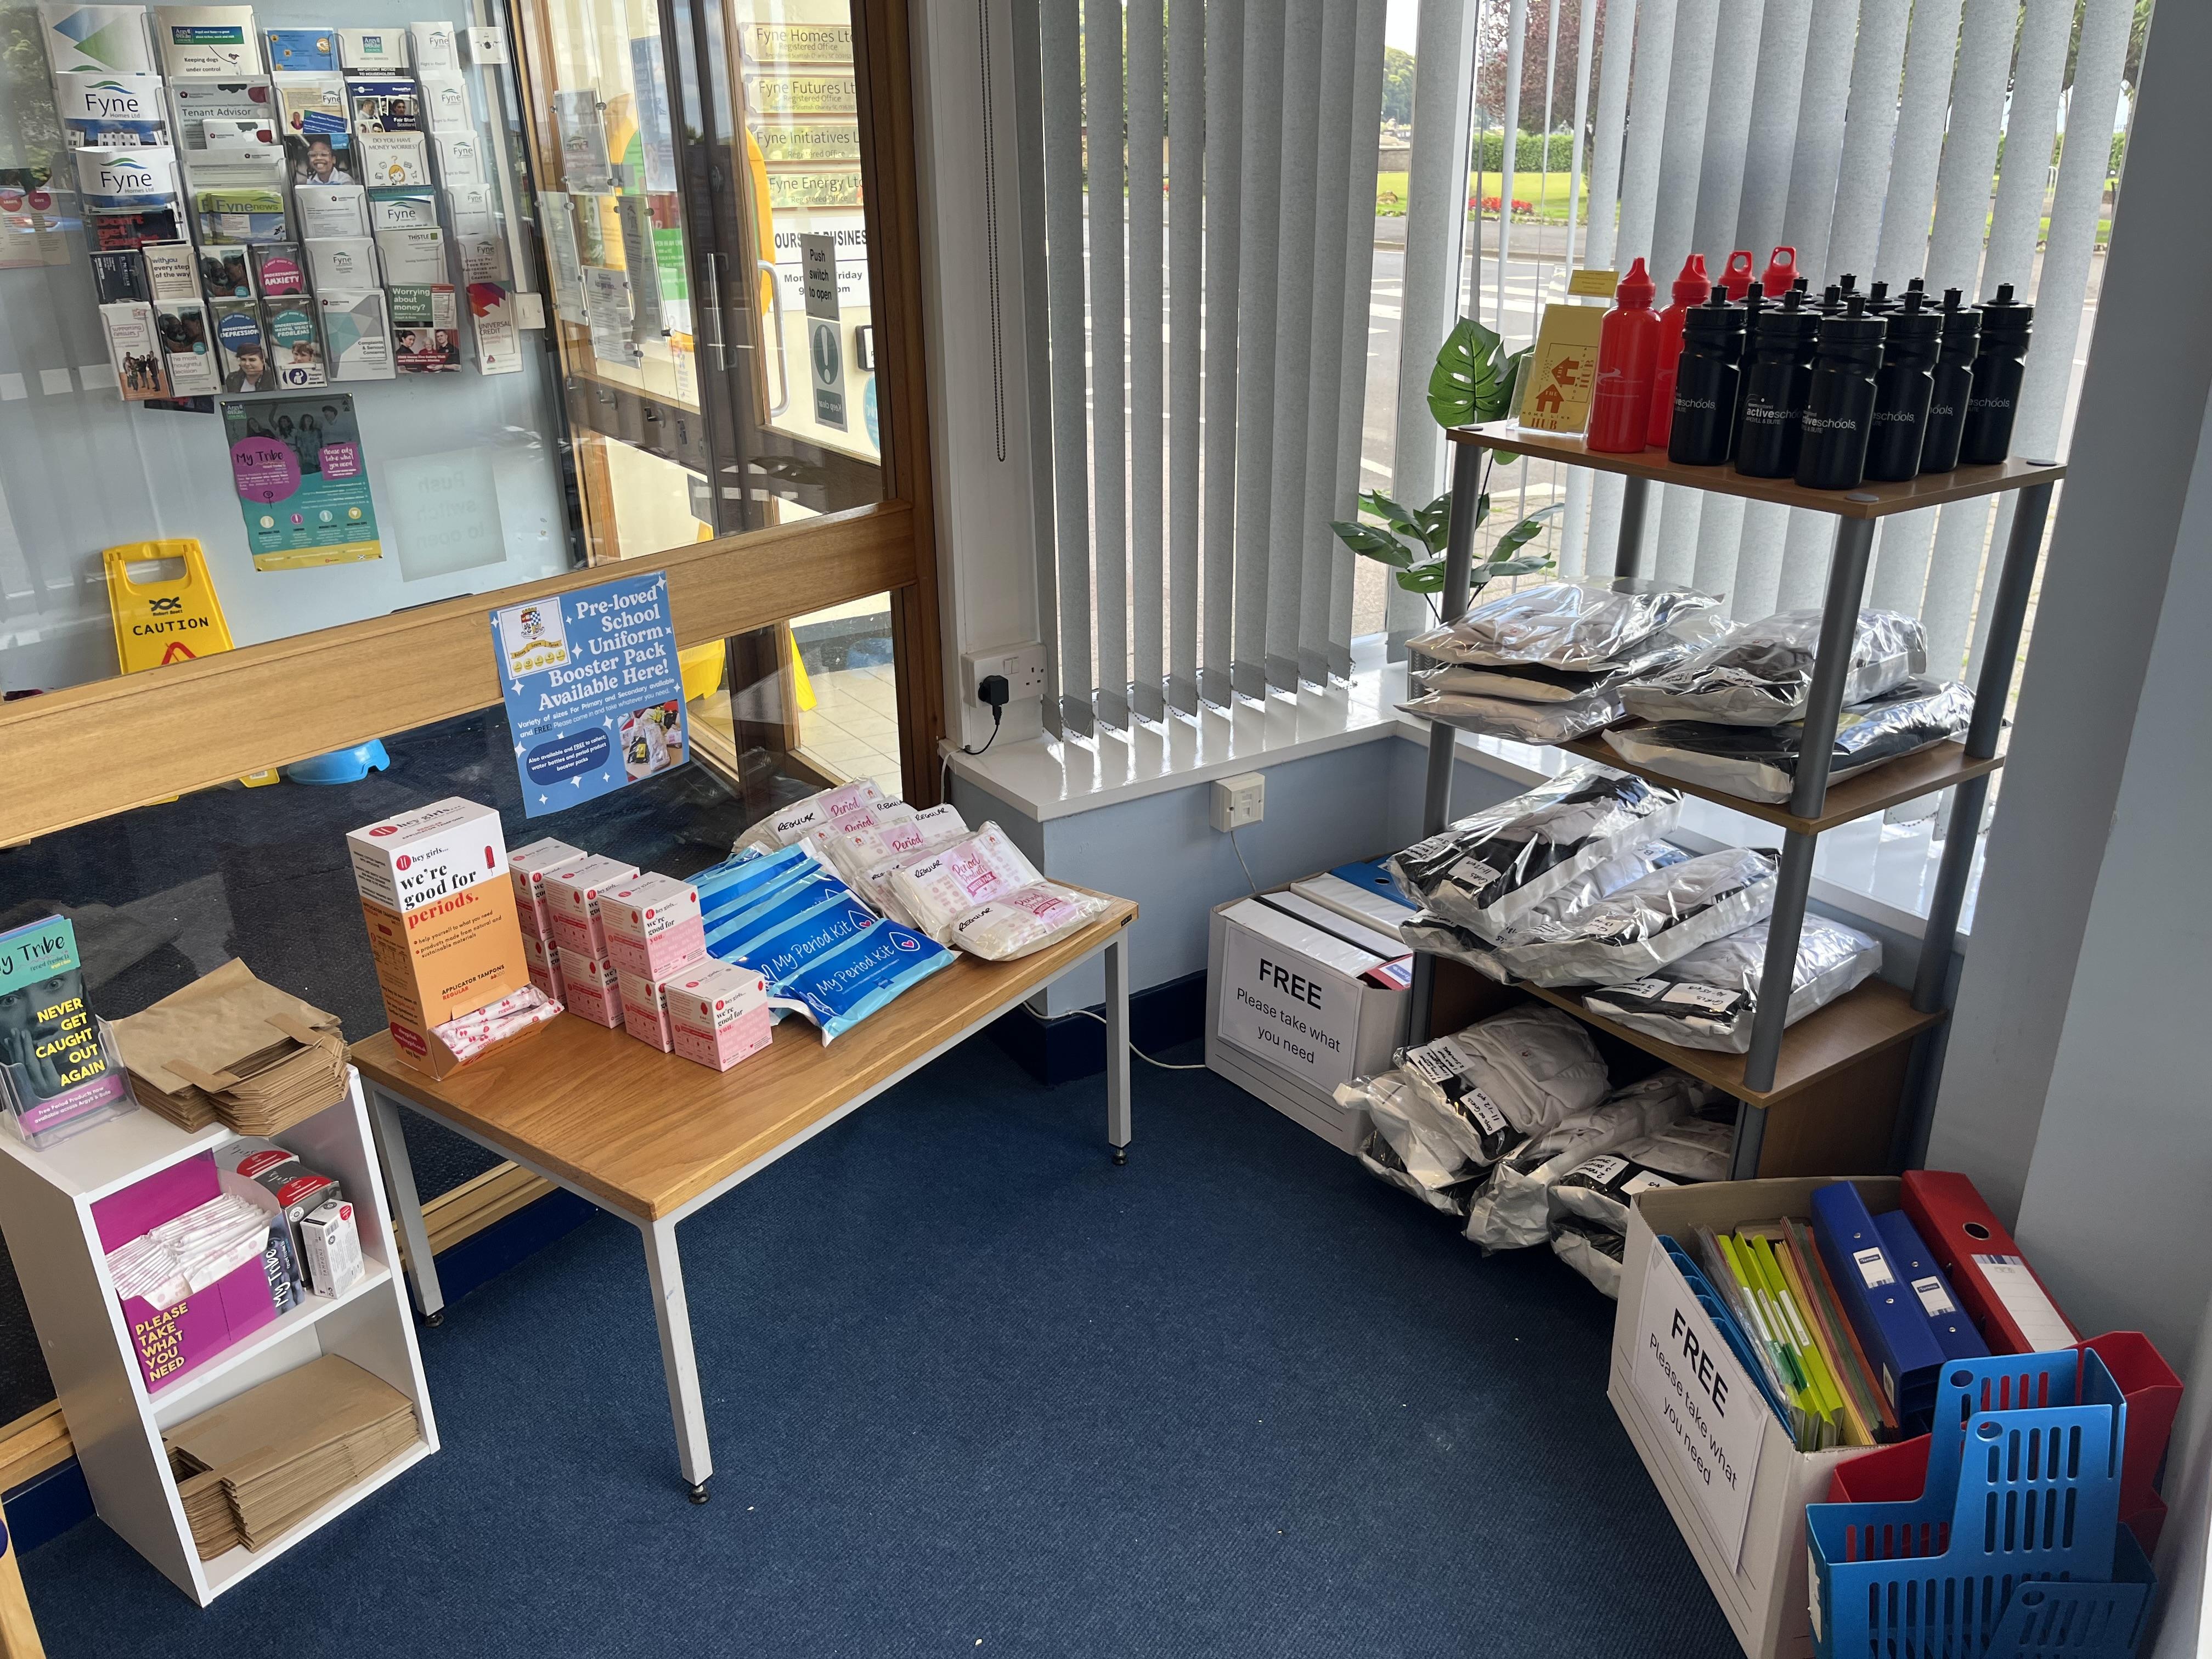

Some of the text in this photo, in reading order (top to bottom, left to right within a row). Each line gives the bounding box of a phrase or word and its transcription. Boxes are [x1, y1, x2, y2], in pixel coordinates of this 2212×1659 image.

[757, 29, 834, 43] Fyne Homes
[442, 94, 461, 104] Fyne
[759, 82, 840, 97] Fyne Futures
[85, 94, 139, 117] Fyne
[217, 108, 251, 116] Advisor
[757, 132, 849, 148] Fyne Initiatives
[454, 148, 473, 156] Fyne
[100, 171, 152, 193] Fyne
[770, 177, 843, 192] Fyne Energy
[388, 209, 415, 222] Fyne
[810, 249, 826, 262] Push
[264, 275, 300, 285] ANXIETY
[809, 268, 829, 281] switch
[392, 287, 431, 296] Worrying
[809, 286, 815, 298] to
[816, 290, 832, 302] open
[394, 304, 426, 312] money?
[221, 329, 259, 338] DEPRESSION
[478, 320, 511, 329] UNIVERSAL
[1530, 417, 1558, 430] HUB
[236, 449, 284, 466] My Tribe
[576, 585, 658, 620] Pre-loved
[133, 617, 209, 636] CAUTION
[601, 603, 661, 633] School
[588, 626, 664, 655] Uniform
[549, 642, 667, 688] Booster Pack
[538, 658, 669, 712] Available Here!
[517, 717, 541, 729] Variety
[543, 714, 551, 722] of
[552, 710, 568, 719] sizes
[582, 698, 603, 711] Primary
[605, 695, 616, 703] and
[618, 686, 647, 698] Secondary
[649, 678, 675, 689] available
[520, 729, 534, 738] and
[534, 724, 553, 735] FREE!
[554, 719, 572, 729] Please
[573, 714, 589, 723] come
[594, 708, 605, 716] and
[606, 704, 618, 713] take
[618, 698, 644, 708] whatever
[644, 693, 654, 702] you
[656, 688, 671, 696] need.
[528, 756, 540, 764] Also
[541, 749, 564, 760] available
[574, 742, 585, 751] FREE
[548, 757, 566, 766] bottles
[575, 748, 589, 760] period
[590, 742, 607, 754] product
[556, 757, 589, 771] booster packs
[831, 797, 860, 817] Period
[915, 807, 949, 821] REGULAR
[778, 812, 816, 832] REGULAR
[892, 833, 923, 851] Period
[412, 855, 425, 863] hey
[914, 860, 943, 878] REGULAR
[952, 853, 980, 876] Period
[404, 878, 447, 911] good
[453, 871, 477, 890] for
[408, 892, 479, 929] periods.
[958, 907, 993, 932] REGULAR
[419, 935, 431, 944] help
[432, 927, 452, 940] yourself
[459, 919, 472, 929] what
[472, 917, 481, 926] you
[481, 910, 493, 921] need
[421, 915, 502, 953] products made from natural and
[16, 936, 65, 961] Tribe
[421, 943, 452, 958] sustainable
[772, 921, 852, 972] My Period Kit
[442, 964, 505, 995] APPLICATOR TAMPONS
[816, 978, 843, 996] My
[834, 956, 877, 983] Period
[872, 945, 894, 961] Kit
[442, 986, 469, 1001] REGULAR
[1259, 957, 1322, 1011] FREE
[37, 997, 84, 1024] NEVER
[60, 1012, 87, 1031] GET
[1237, 987, 1341, 1053] Please take what
[35, 1028, 93, 1059] CAUGHT
[69, 1043, 99, 1064] OUT
[1257, 1025, 1314, 1064] you need
[60, 1059, 106, 1087] AGAIN
[35, 1111, 59, 1124] available
[60, 1104, 78, 1113] across
[78, 1097, 94, 1107] Argyll
[51, 1099, 69, 1110] Period
[69, 1091, 92, 1103] Products
[1484, 1103, 1500, 1121] 11-12
[264, 1248, 291, 1308] My Tribe
[135, 1302, 188, 1335] PLEASE
[138, 1323, 177, 1347] TAKE
[141, 1331, 183, 1358] WHAT
[145, 1348, 178, 1370] YOU
[149, 1357, 185, 1383] NEED
[1671, 1307, 1729, 1418] FREE
[1650, 1332, 1737, 1491] Please take what
[1663, 1396, 1712, 1486] you need
